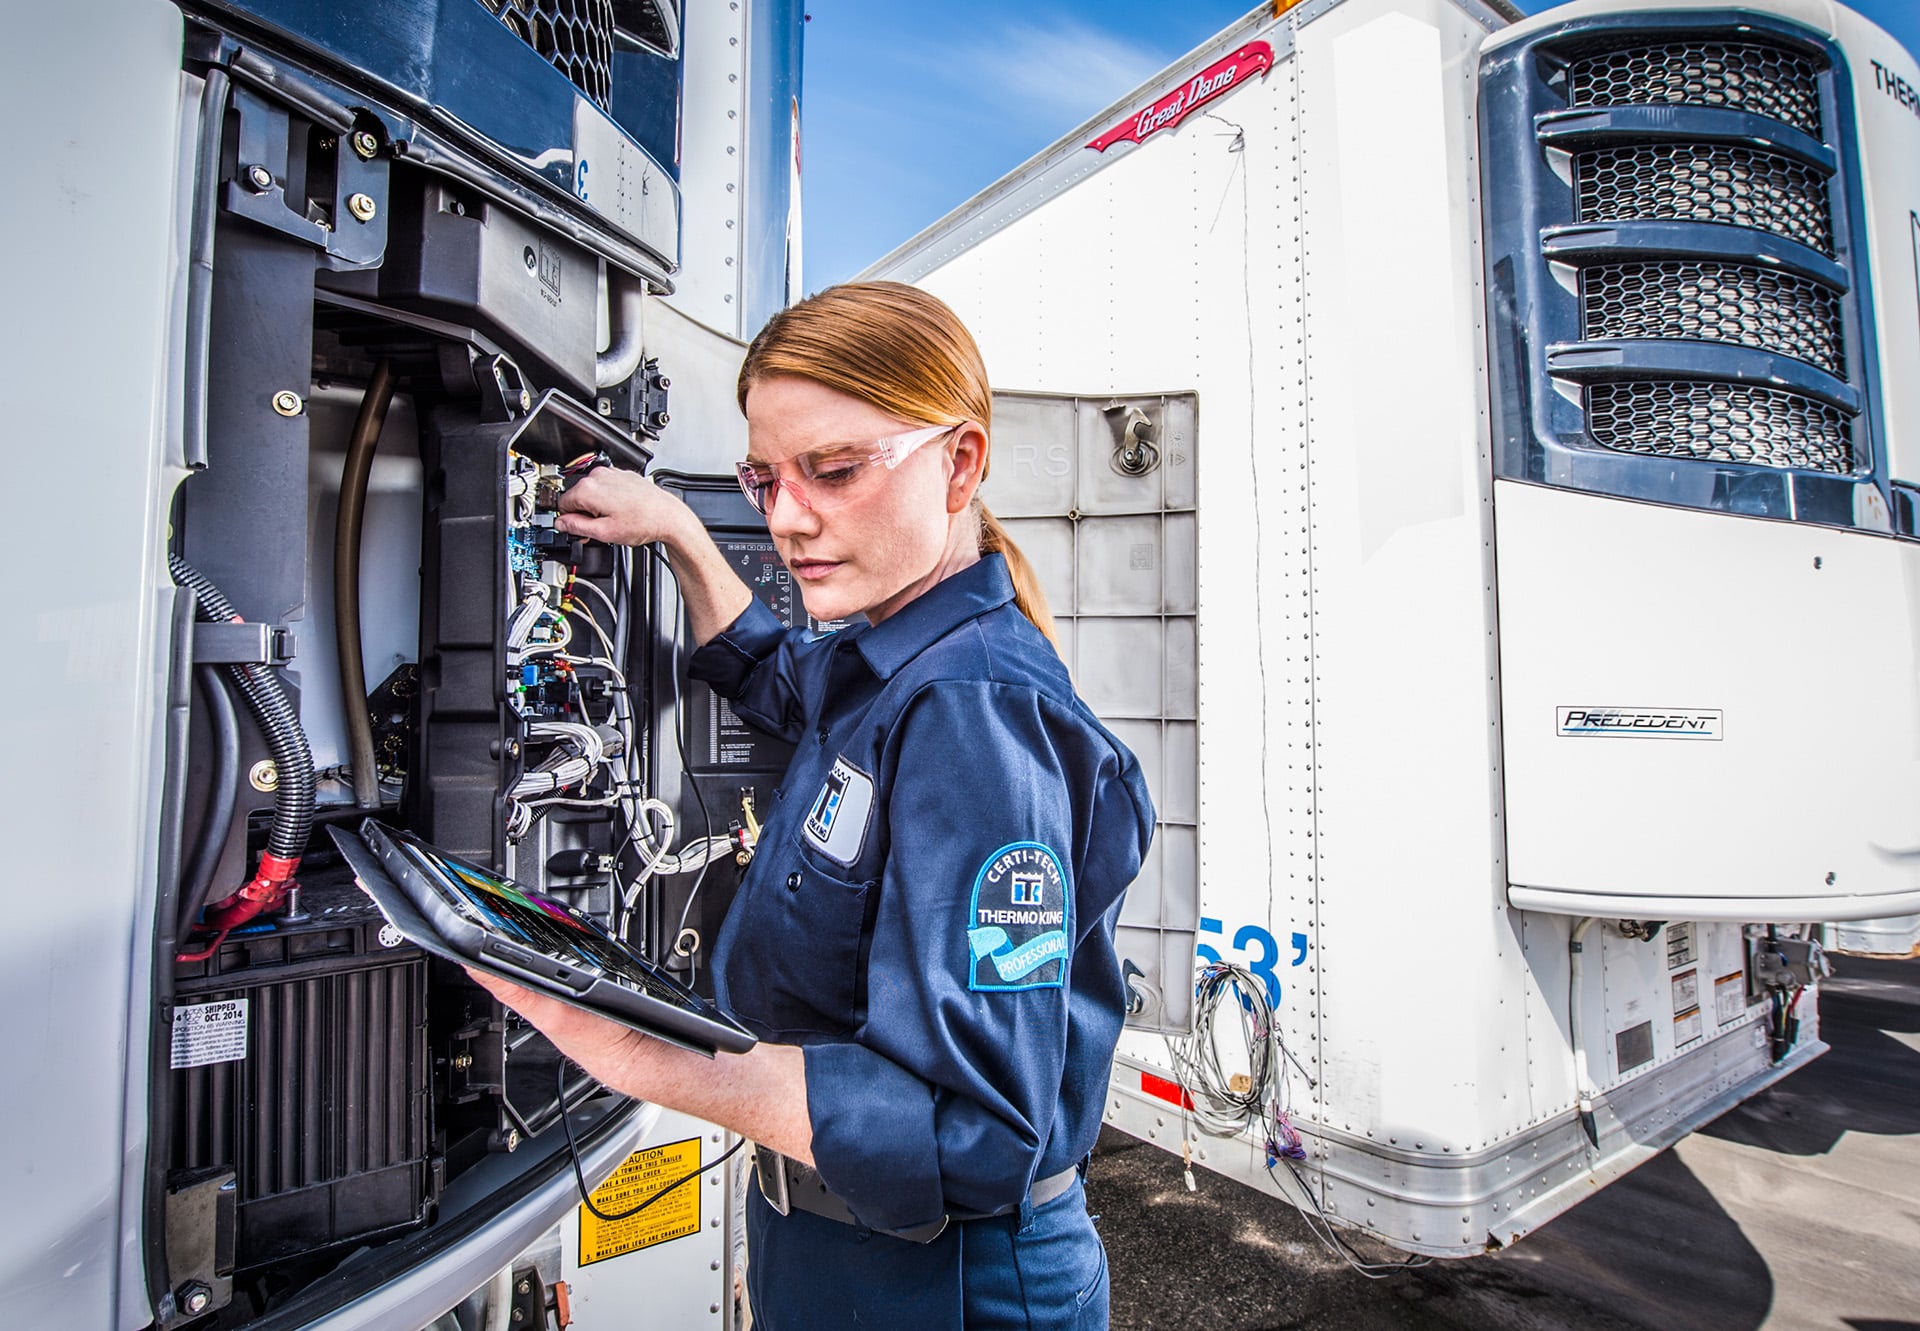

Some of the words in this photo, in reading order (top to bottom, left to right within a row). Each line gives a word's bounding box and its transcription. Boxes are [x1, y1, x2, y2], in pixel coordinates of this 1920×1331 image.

[1137, 93, 1185, 138] Great
[1184, 65, 1237, 109] Dane
[1564, 711, 1718, 729] PRECEDENT
[987, 850, 1061, 884] CERTI-TECH
[978, 909, 1038, 925] THERMO
[1039, 911, 1064, 925] KING
[1000, 935, 1067, 977] PROFESSIONAL
[205, 1003, 236, 1014] SHIPPED
[205, 1013, 221, 1022] OCT.
[223, 1010, 243, 1020] 2014
[621, 1163, 643, 1174] TOWING
[645, 1160, 658, 1169] THIS
[660, 1154, 682, 1165] TRAILER
[621, 1173, 641, 1183] VISUAL
[643, 1169, 661, 1179] CHECK
[596, 1195, 613, 1204] MAKE
[615, 1190, 630, 1199] SURE
[646, 1183, 657, 1191] ARE
[596, 1249, 612, 1257] MAKE
[615, 1243, 630, 1252] SURE
[632, 1239, 646, 1248] LEGS
[648, 1234, 659, 1242] ARE
[660, 1226, 685, 1239] CRANKED
[687, 1223, 695, 1231] UP
